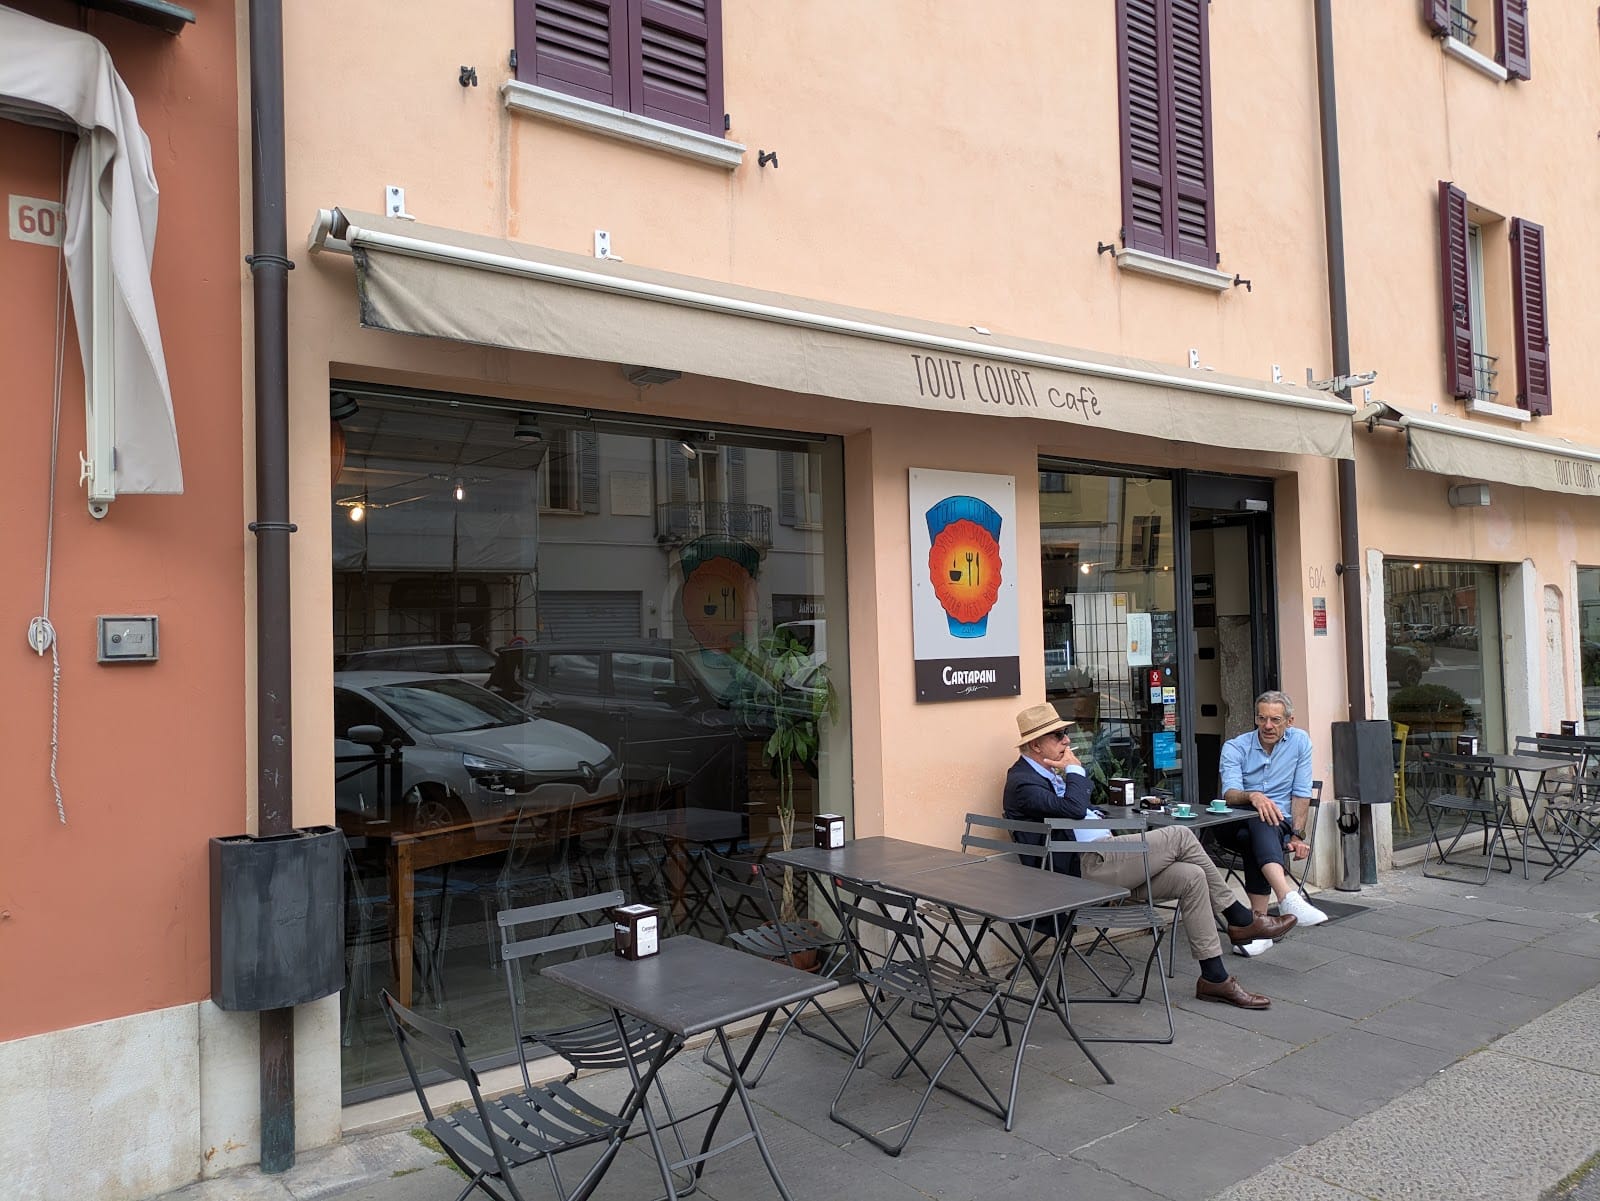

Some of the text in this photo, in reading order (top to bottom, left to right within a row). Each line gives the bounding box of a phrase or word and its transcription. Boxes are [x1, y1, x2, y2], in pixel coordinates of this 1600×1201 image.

[911, 354, 1102, 421] TOUT COURT cafè
[1554, 459, 1596, 489] TOUT COURT
[942, 665, 996, 686] CARTAPANI
